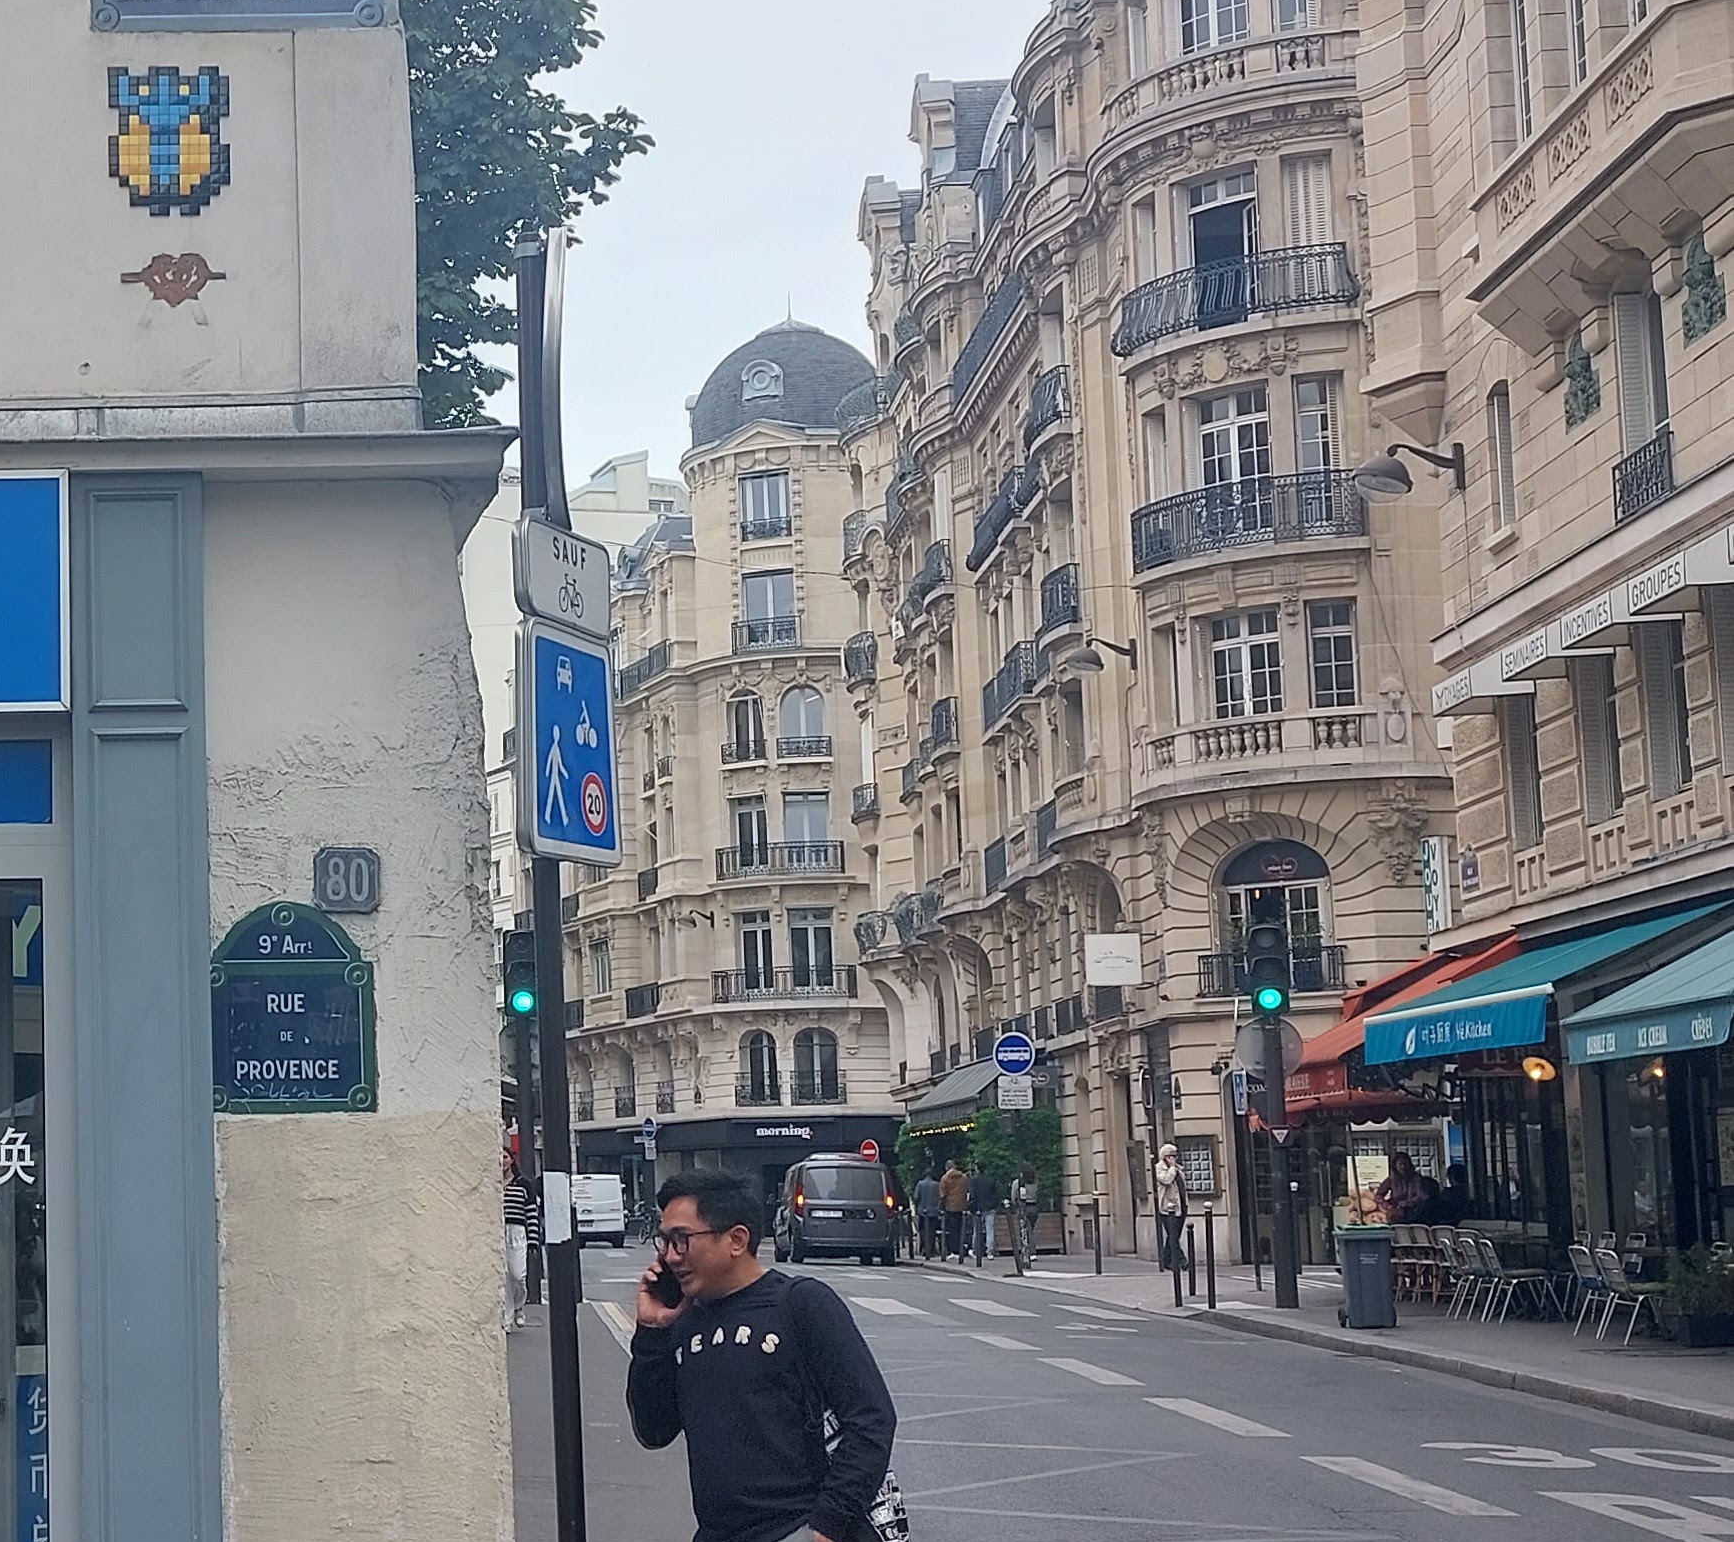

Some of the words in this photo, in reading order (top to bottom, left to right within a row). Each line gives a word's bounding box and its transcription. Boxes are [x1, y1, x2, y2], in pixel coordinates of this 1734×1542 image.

[552, 536, 587, 570] SAUF
[1631, 561, 1681, 607] GROUPES
[1562, 600, 1609, 642] INCENTIVES
[1504, 634, 1546, 675] SEMINAIRES
[1435, 676, 1470, 709] VOYAGES
[587, 792, 601, 811] 20
[326, 858, 370, 902] 80
[266, 993, 305, 1013] RUE
[280, 1031, 293, 1042] DE
[236, 1059, 340, 1081] PROVENCE
